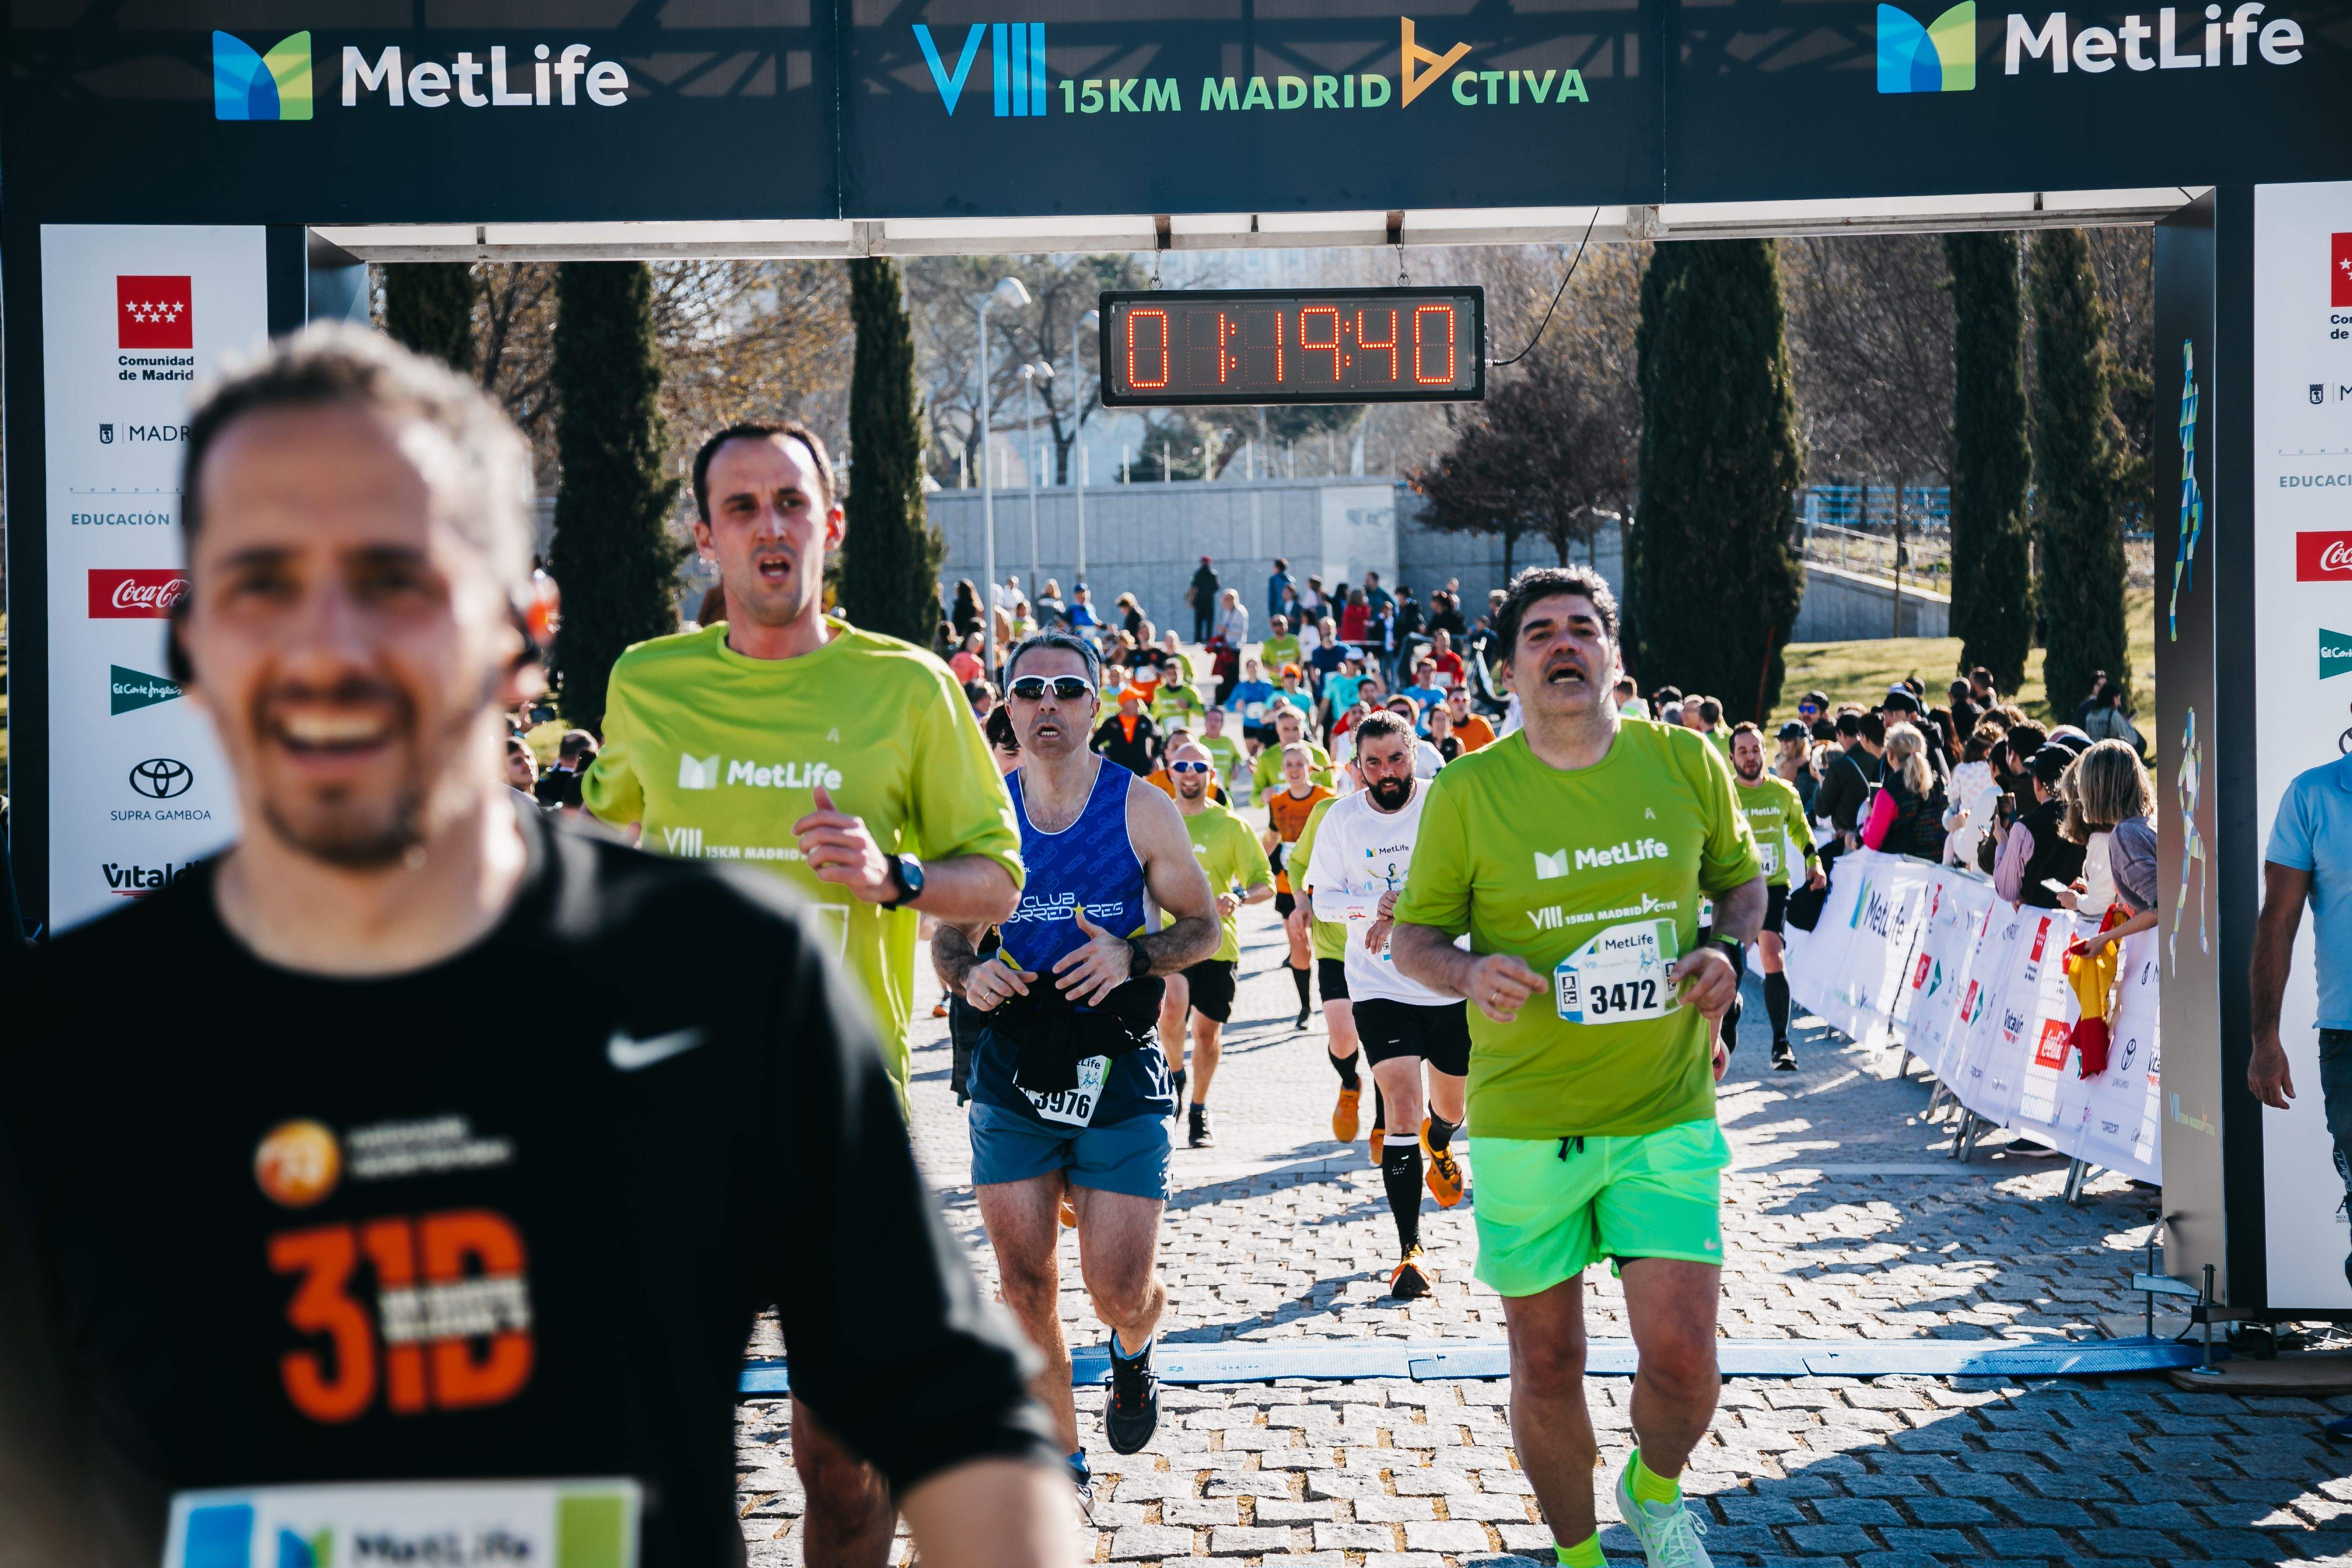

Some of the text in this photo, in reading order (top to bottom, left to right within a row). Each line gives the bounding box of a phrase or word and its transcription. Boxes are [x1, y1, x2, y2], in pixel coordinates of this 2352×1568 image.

[2005, 2, 2304, 75] MetLife
[343, 44, 628, 107] MetLife
[912, 22, 1046, 117] VIII
[1058, 78, 1181, 113] 15KM
[1200, 74, 1391, 112] MADRID
[2331, 329, 2349, 339] de
[118, 356, 194, 365] Comunidad
[119, 370, 194, 380] de Madrid
[129, 426, 191, 441] MADR
[2280, 475, 2352, 487] EDUCACI
[71, 510, 169, 525] EDUCACIÓN
[112, 579, 189, 609] Coca-Co
[2321, 646, 2352, 658] El Cort
[113, 681, 182, 698] El Corte Inglés
[727, 760, 843, 790] MetLife
[111, 810, 211, 820] SUPRA GAMBOA
[663, 826, 798, 861] VIII 15KM MADRID
[1379, 844, 1409, 855] MetLife
[1575, 838, 1669, 870] MetLife
[102, 861, 201, 888] Vitald
[1022, 892, 1075, 908] CLUB
[1527, 905, 1563, 930] VIII
[1565, 913, 1595, 925] 15KM
[1597, 906, 1642, 921] MADRID
[1864, 890, 1904, 946] MetLife
[1605, 934, 1653, 951] MetLife
[1590, 979, 1658, 1015] 3472
[1034, 1091, 1092, 1119] 3976
